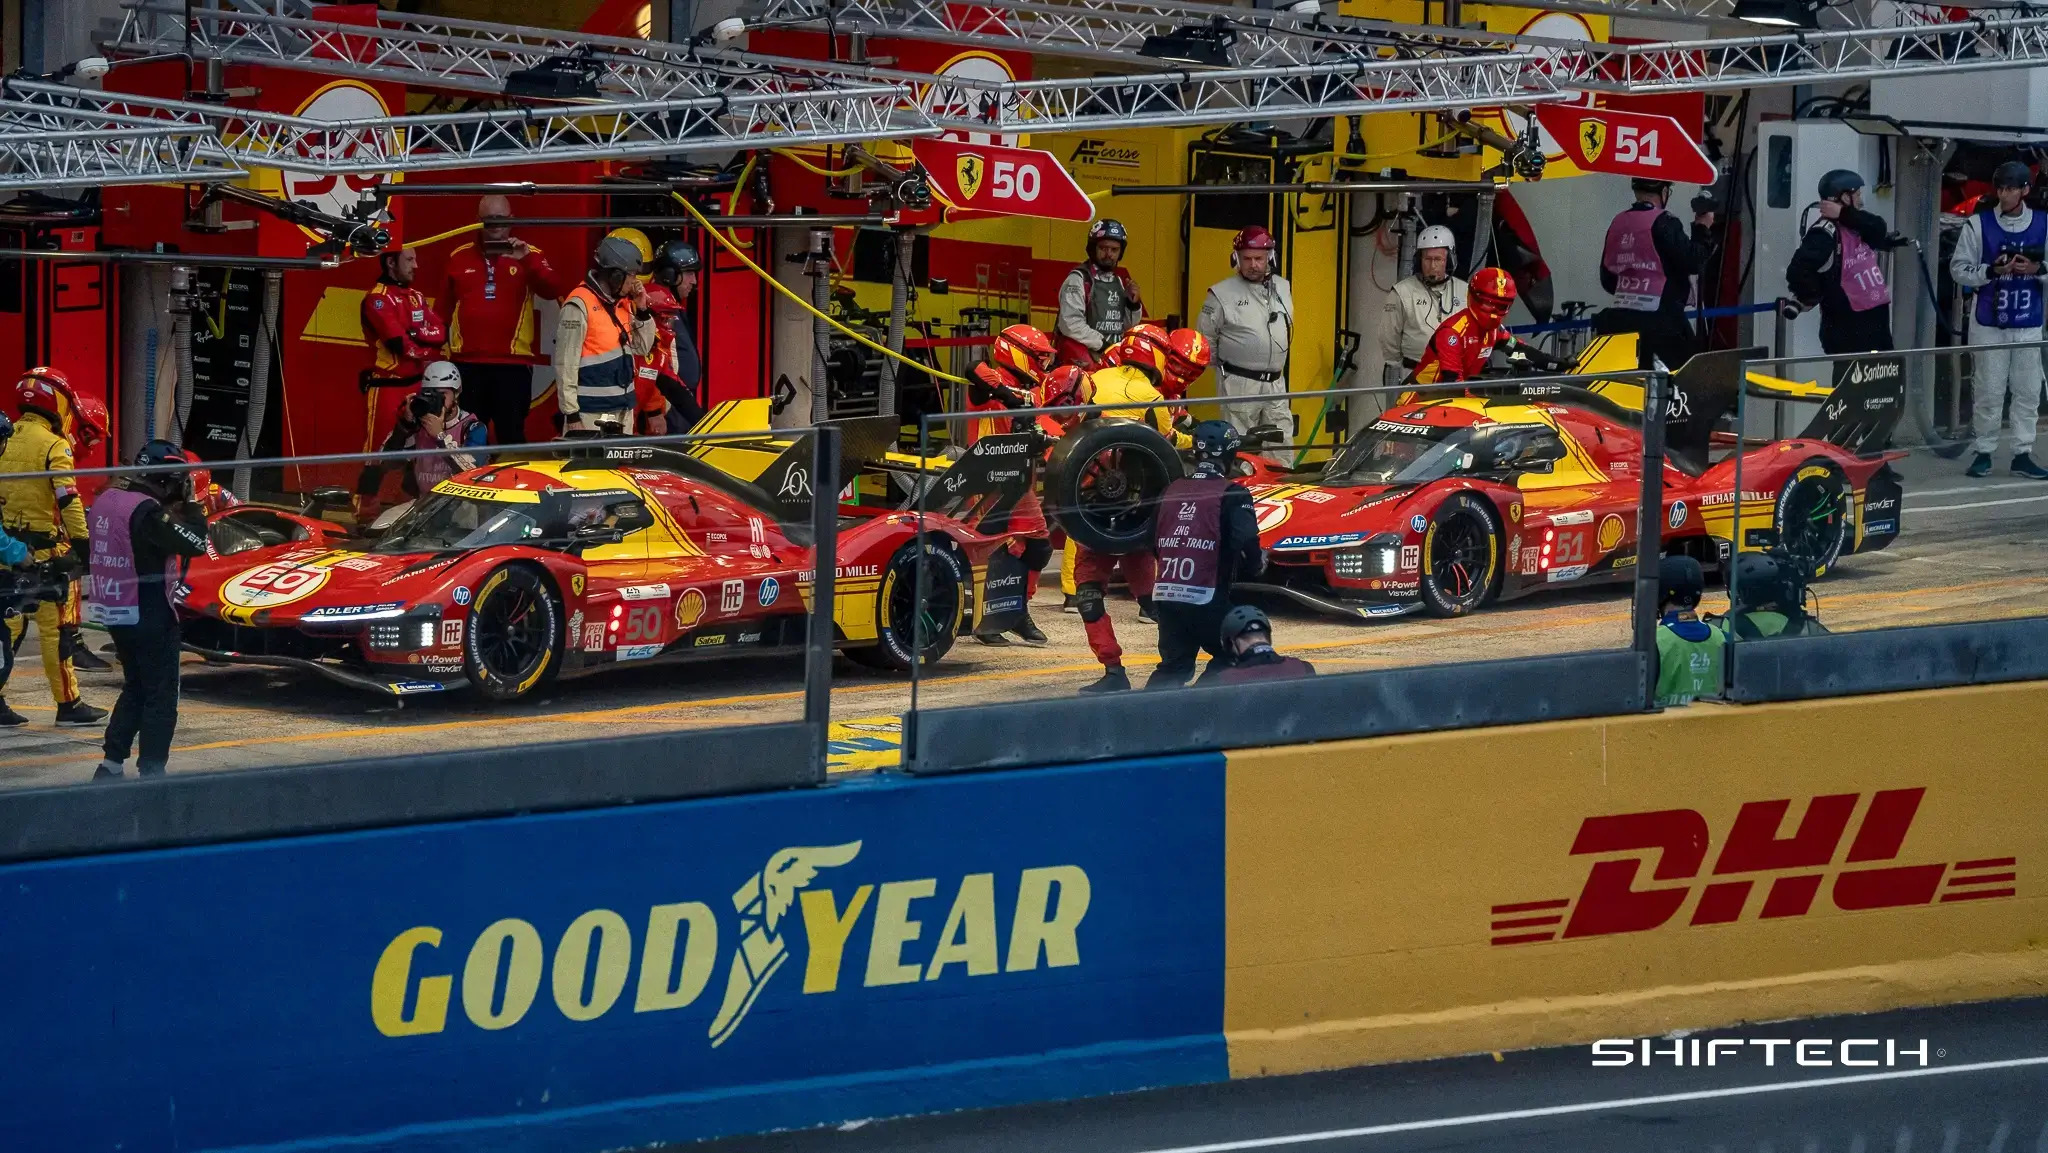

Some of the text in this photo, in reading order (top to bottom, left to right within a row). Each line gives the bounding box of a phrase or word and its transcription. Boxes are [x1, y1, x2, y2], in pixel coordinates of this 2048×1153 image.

[1614, 125, 1663, 167] 51
[992, 161, 1041, 202] 50
[1997, 289, 2032, 310] 313
[1863, 361, 1900, 383] Santander
[1521, 386, 1546, 395] ADLER
[1369, 419, 1430, 436] Ferrari
[606, 450, 634, 459] ADLER
[984, 442, 1029, 456] Santander
[437, 482, 498, 500] Ferrari
[1701, 492, 1737, 506] RICHAR
[1669, 500, 1688, 529] hp
[1173, 525, 1190, 536] ENG
[1411, 514, 1428, 534] hp
[1186, 537, 1216, 551] TRACK
[1279, 536, 1327, 545] ADLER
[1556, 532, 1585, 563] 51
[381, 569, 427, 587] RICHARD
[845, 564, 878, 577] MILLE
[1161, 557, 1195, 581] 710
[247, 567, 306, 590] 50
[1383, 580, 1419, 589] V-Power
[452, 586, 472, 606] hp
[759, 577, 780, 607] hp
[311, 606, 362, 616] ADLER
[991, 600, 1018, 610] MICHELIN
[625, 605, 662, 641] 50
[469, 616, 481, 665] MICHELIN
[421, 655, 462, 664] V-Power
[1560, 787, 1948, 940] DHL
